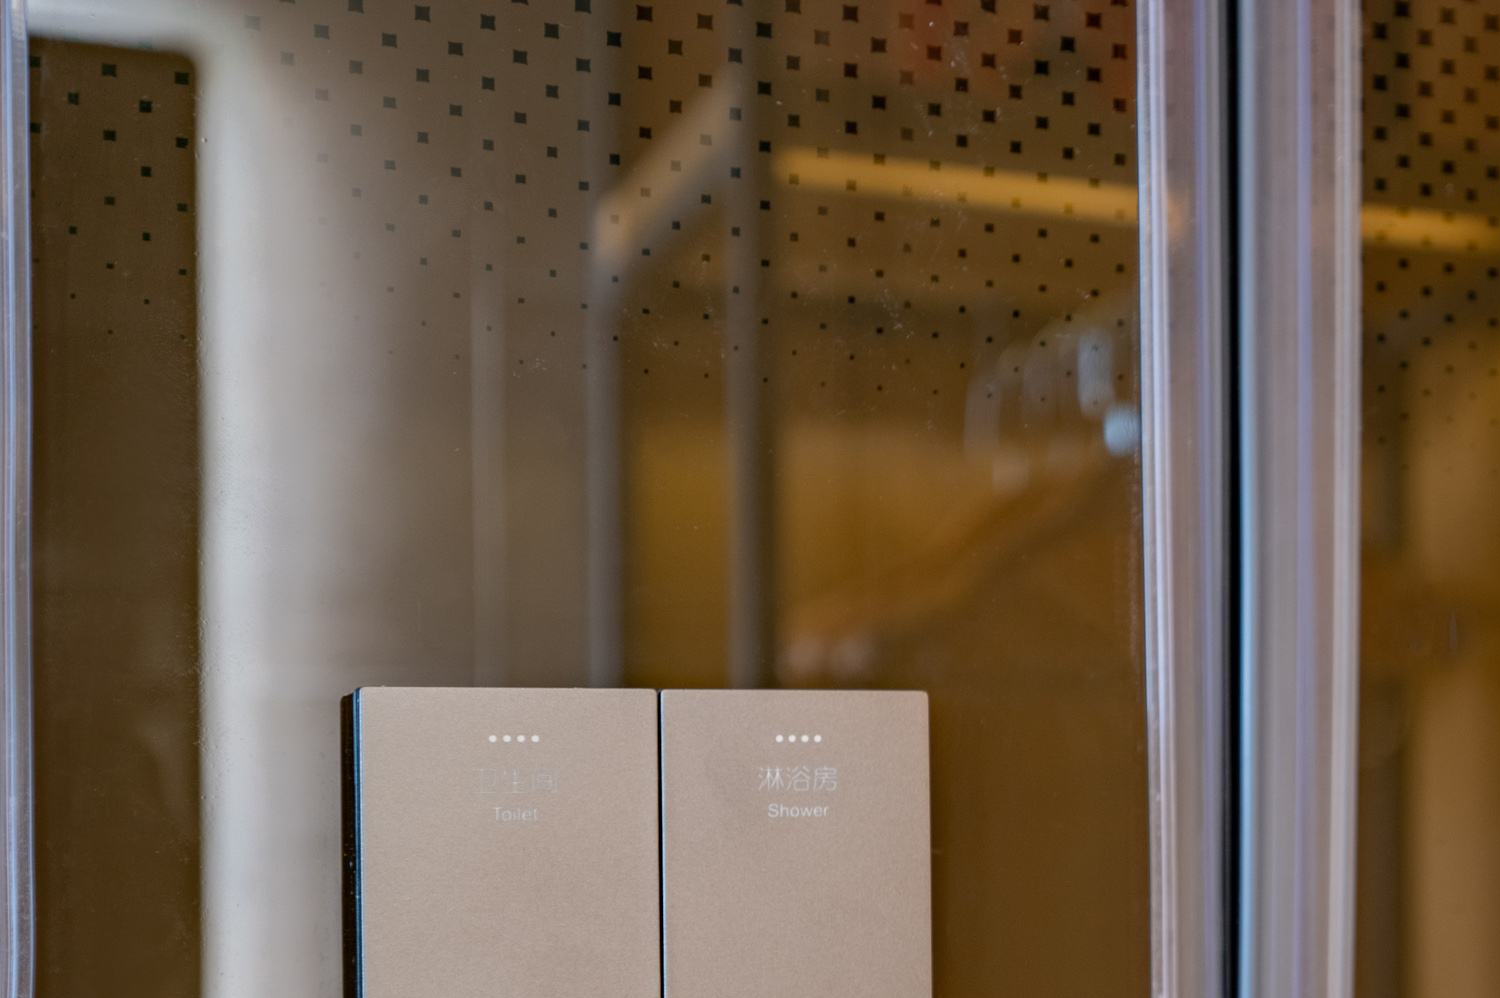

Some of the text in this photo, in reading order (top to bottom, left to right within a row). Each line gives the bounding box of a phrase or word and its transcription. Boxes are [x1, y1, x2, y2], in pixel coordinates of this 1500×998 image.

[758, 765, 837, 792] 淋浴房
[492, 806, 539, 821] Toilet
[768, 803, 829, 818] Shower
